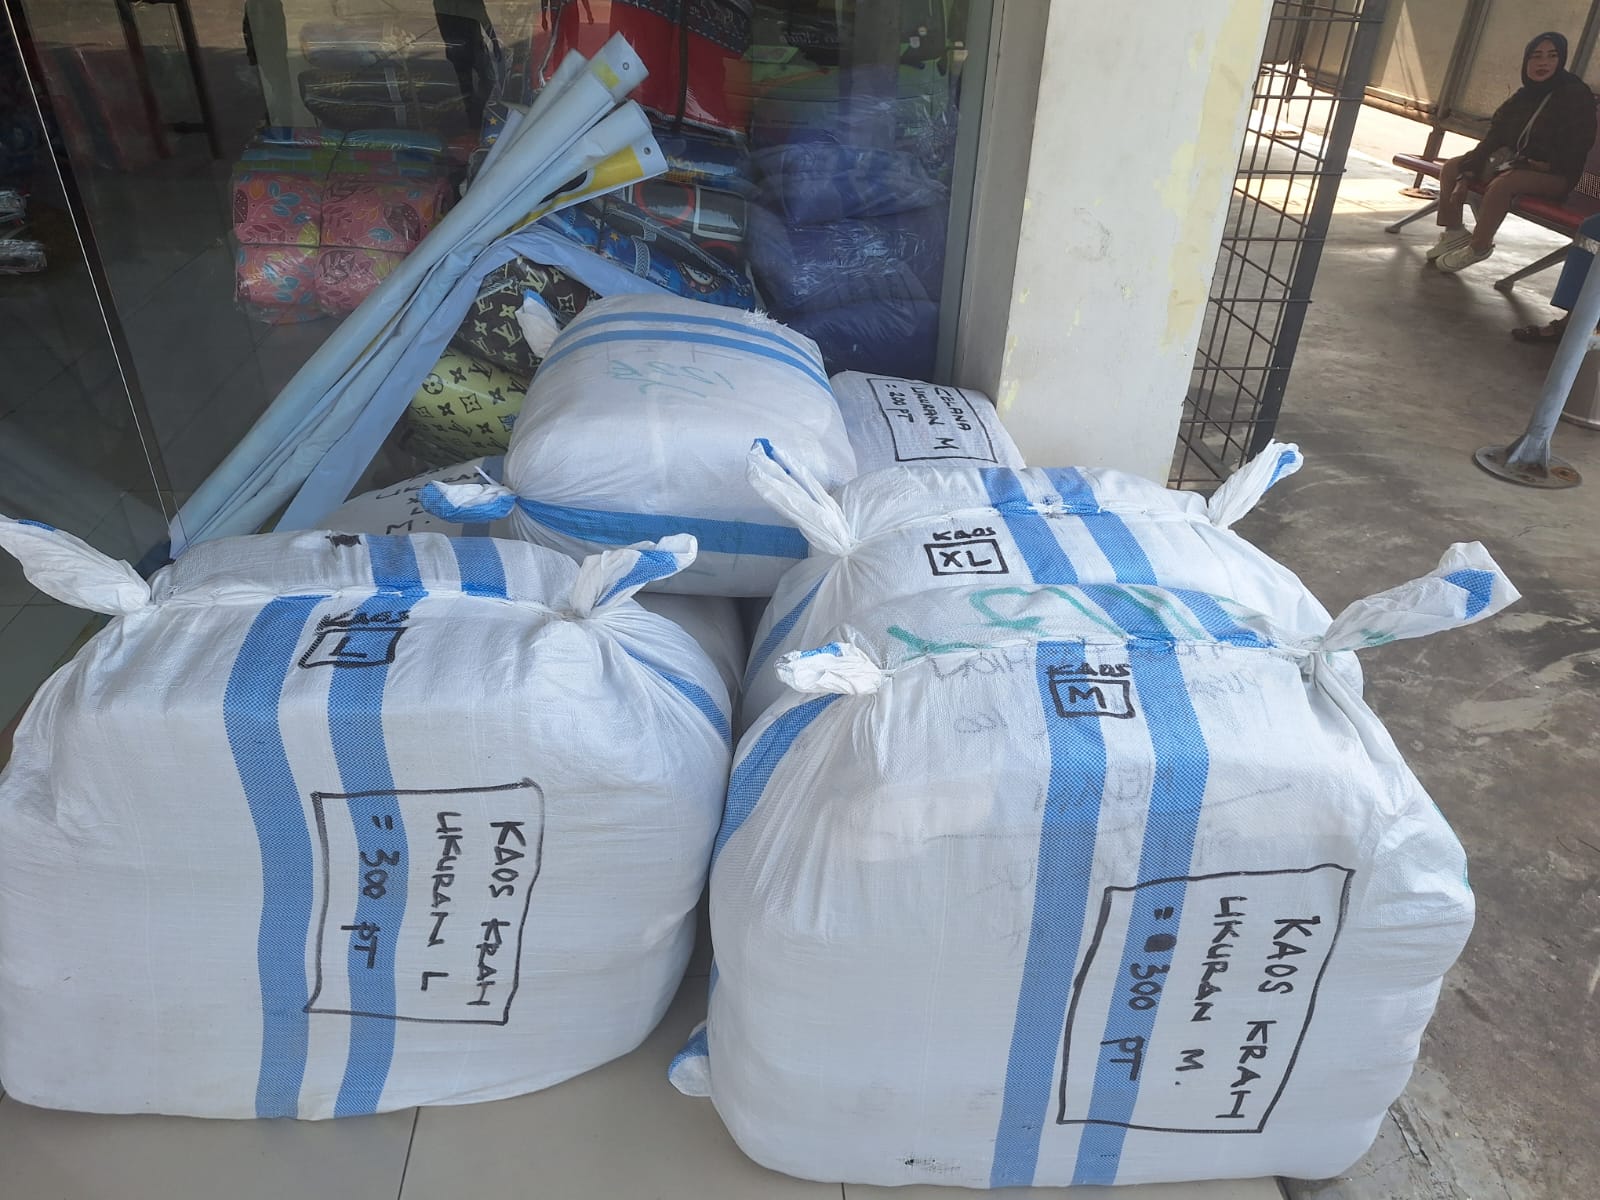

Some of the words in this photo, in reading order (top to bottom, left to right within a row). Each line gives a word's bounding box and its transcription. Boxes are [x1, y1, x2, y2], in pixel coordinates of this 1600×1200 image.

[911, 386, 945, 426] UKURAN
[933, 437, 960, 450] M
[934, 387, 971, 431] CELANA
[939, 550, 992, 568] XL
[328, 636, 368, 658] L
[1068, 686, 1107, 710] M
[360, 850, 400, 900] 300
[427, 811, 463, 947] UKURAN
[488, 821, 527, 898] KAOS
[420, 971, 449, 991] L
[466, 918, 510, 1006] KRAH
[1190, 896, 1247, 1022] UKURAN
[1257, 915, 1321, 994] KAOS
[1128, 962, 1171, 1011] 300
[1215, 1020, 1277, 1119] KRAH
